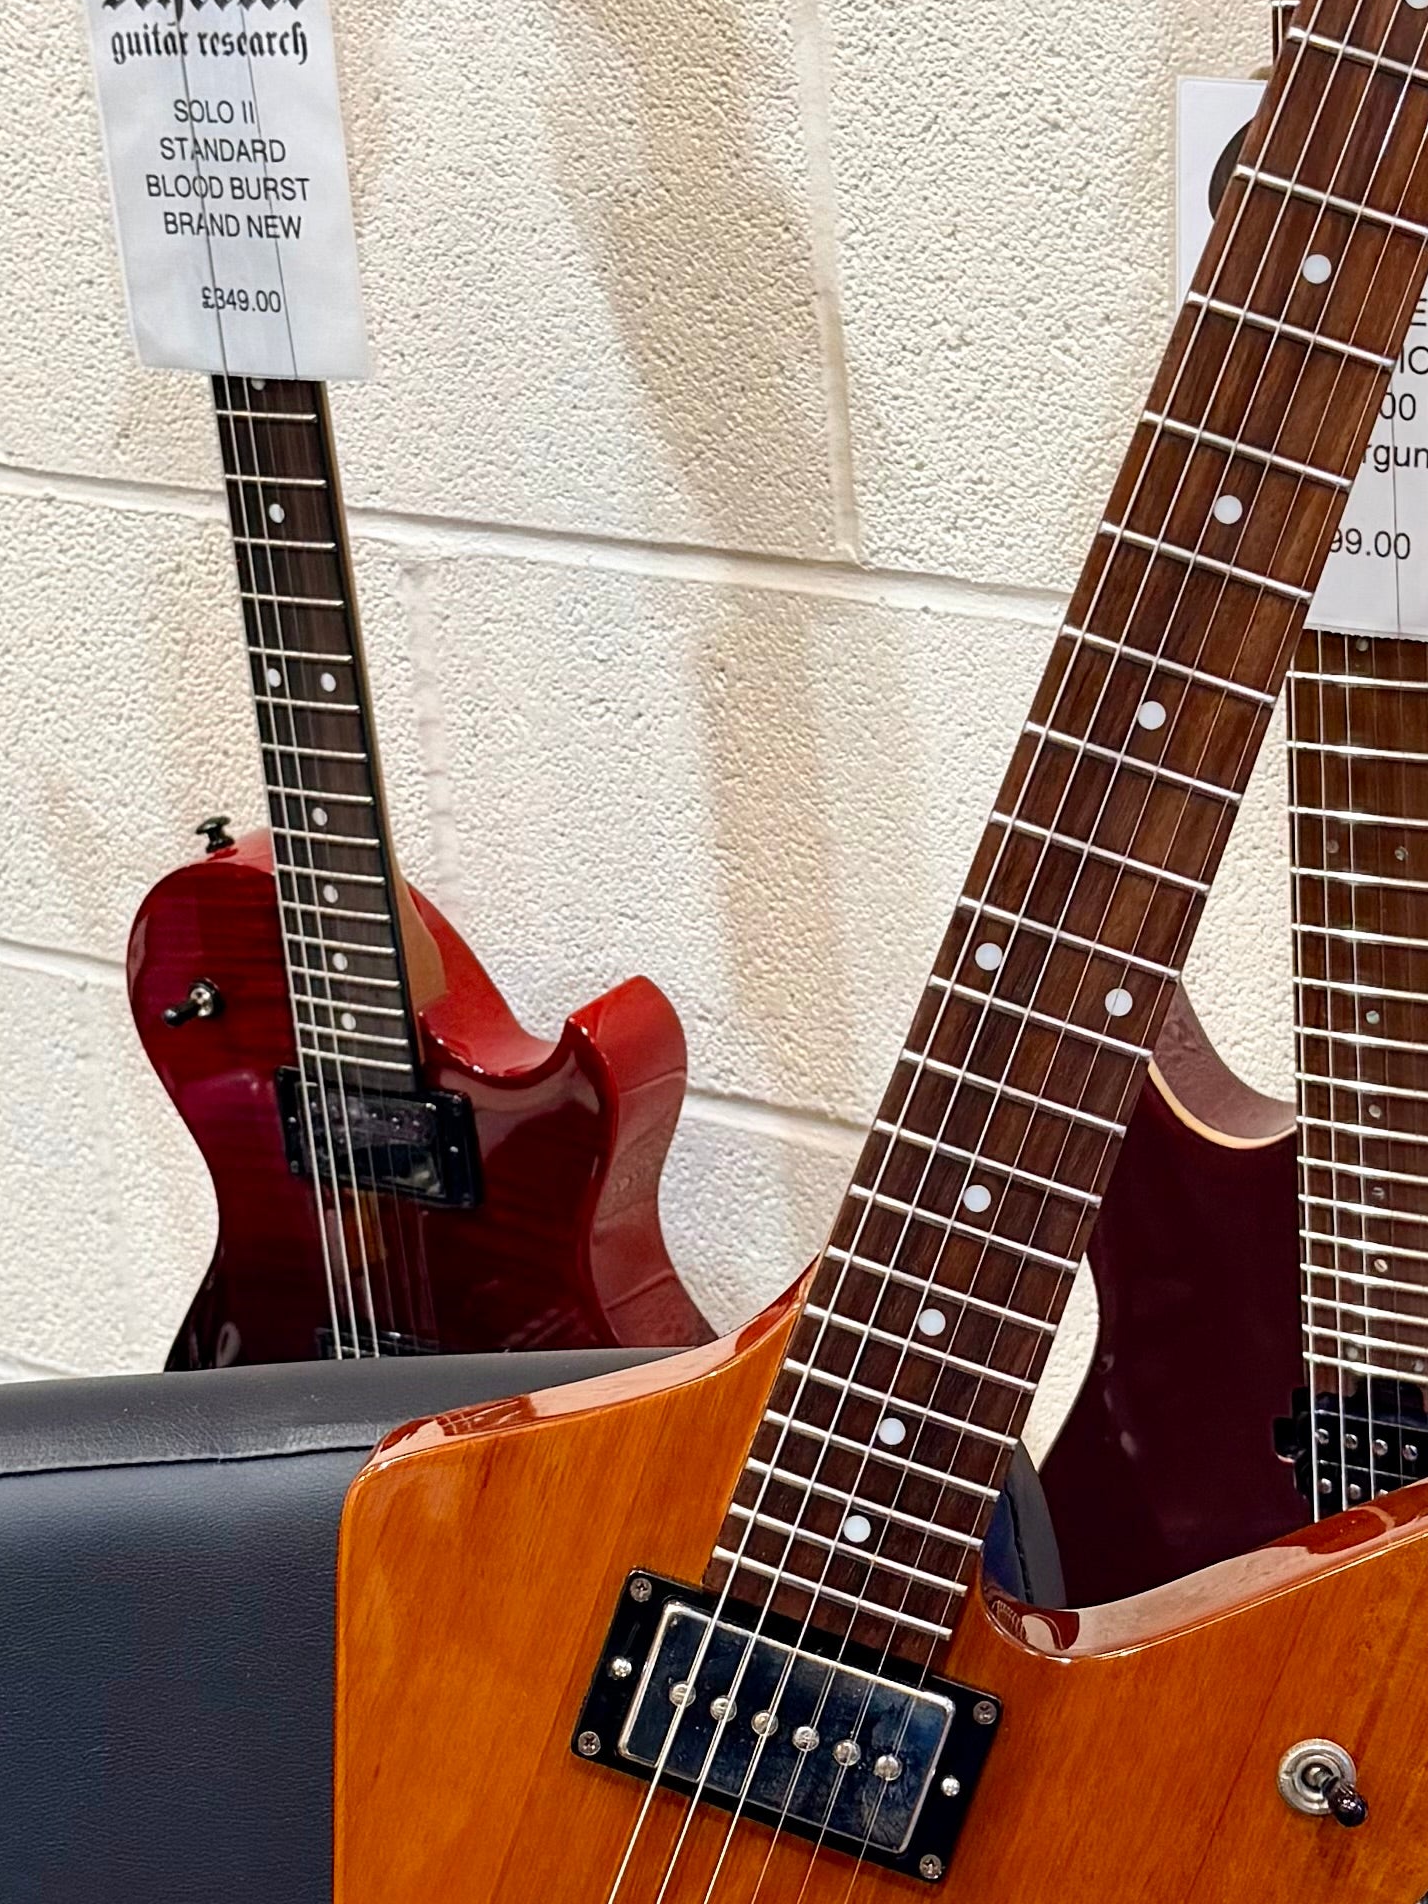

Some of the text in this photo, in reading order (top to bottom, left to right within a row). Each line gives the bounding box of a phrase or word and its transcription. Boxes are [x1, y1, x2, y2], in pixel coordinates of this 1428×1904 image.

[112, 22, 308, 65] guitar research
[174, 100, 234, 123] SOLO
[160, 138, 286, 163] STANDARD
[146, 174, 310, 201] BLOOD BURST
[164, 212, 301, 239] BRAND NEW
[201, 287, 281, 313] £349.00
[1380, 392, 1416, 421] 00
